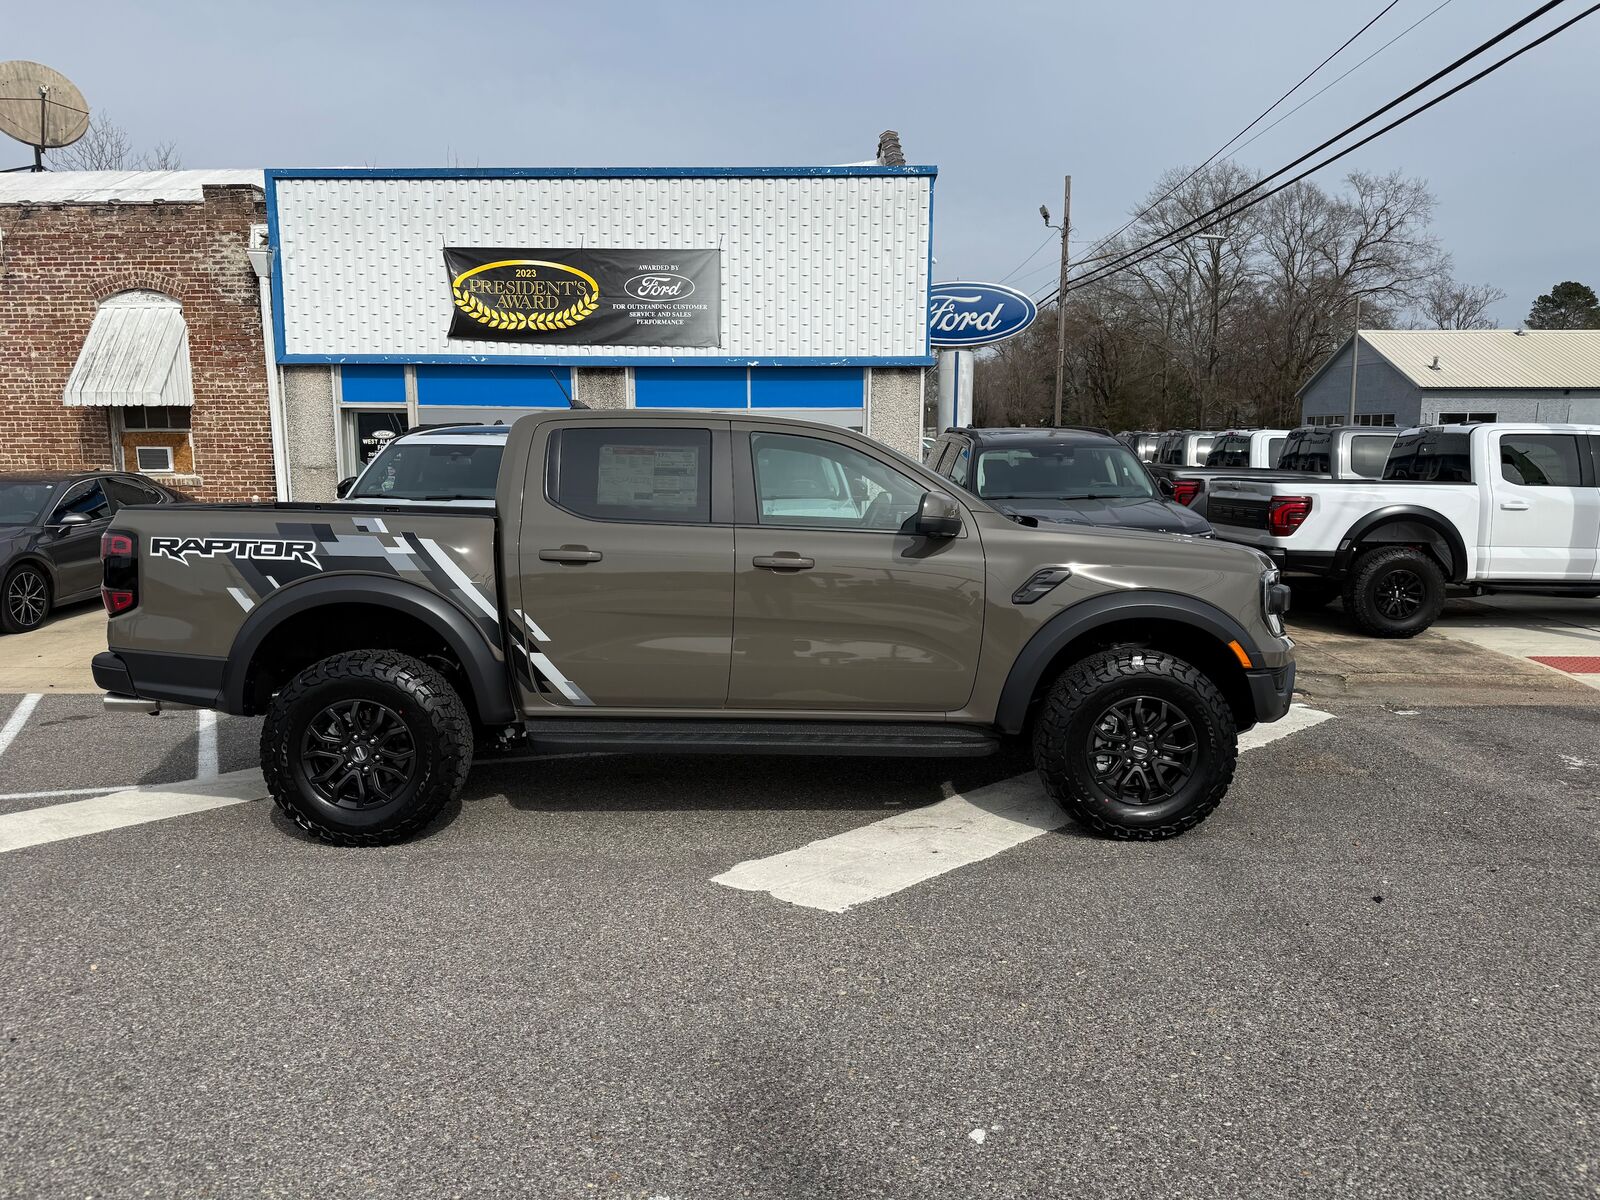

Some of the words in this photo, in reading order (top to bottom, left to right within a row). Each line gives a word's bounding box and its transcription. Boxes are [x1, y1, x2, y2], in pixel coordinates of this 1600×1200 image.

[515, 269, 537, 278] 2023
[468, 278, 587, 296] PRESIDENT'S
[637, 276, 682, 296] Ford
[494, 294, 560, 310] AWARD
[930, 295, 1005, 331] Ford
[150, 536, 324, 572] RAPTOR
